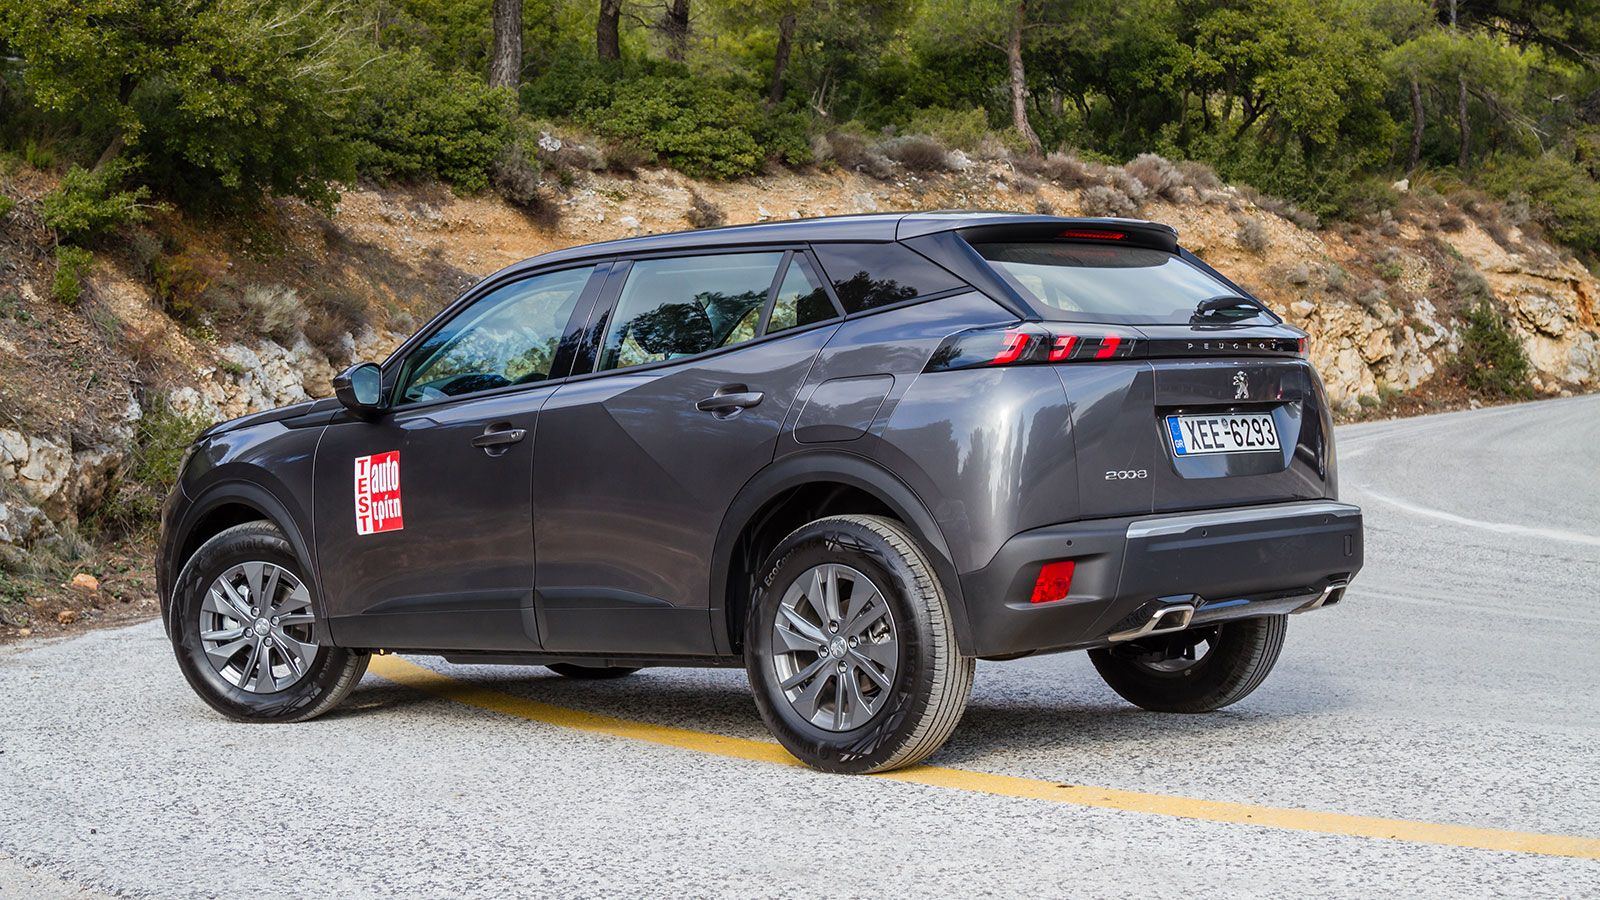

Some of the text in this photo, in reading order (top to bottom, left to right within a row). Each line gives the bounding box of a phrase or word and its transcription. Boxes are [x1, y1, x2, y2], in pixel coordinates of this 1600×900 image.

[1187, 342, 1276, 350] PEUGEOT
[1174, 439, 1185, 449] GR
[1184, 418, 1275, 450] XEE-6293
[371, 455, 399, 494] auto
[1104, 469, 1148, 481] 2008
[357, 459, 370, 532] TEST
